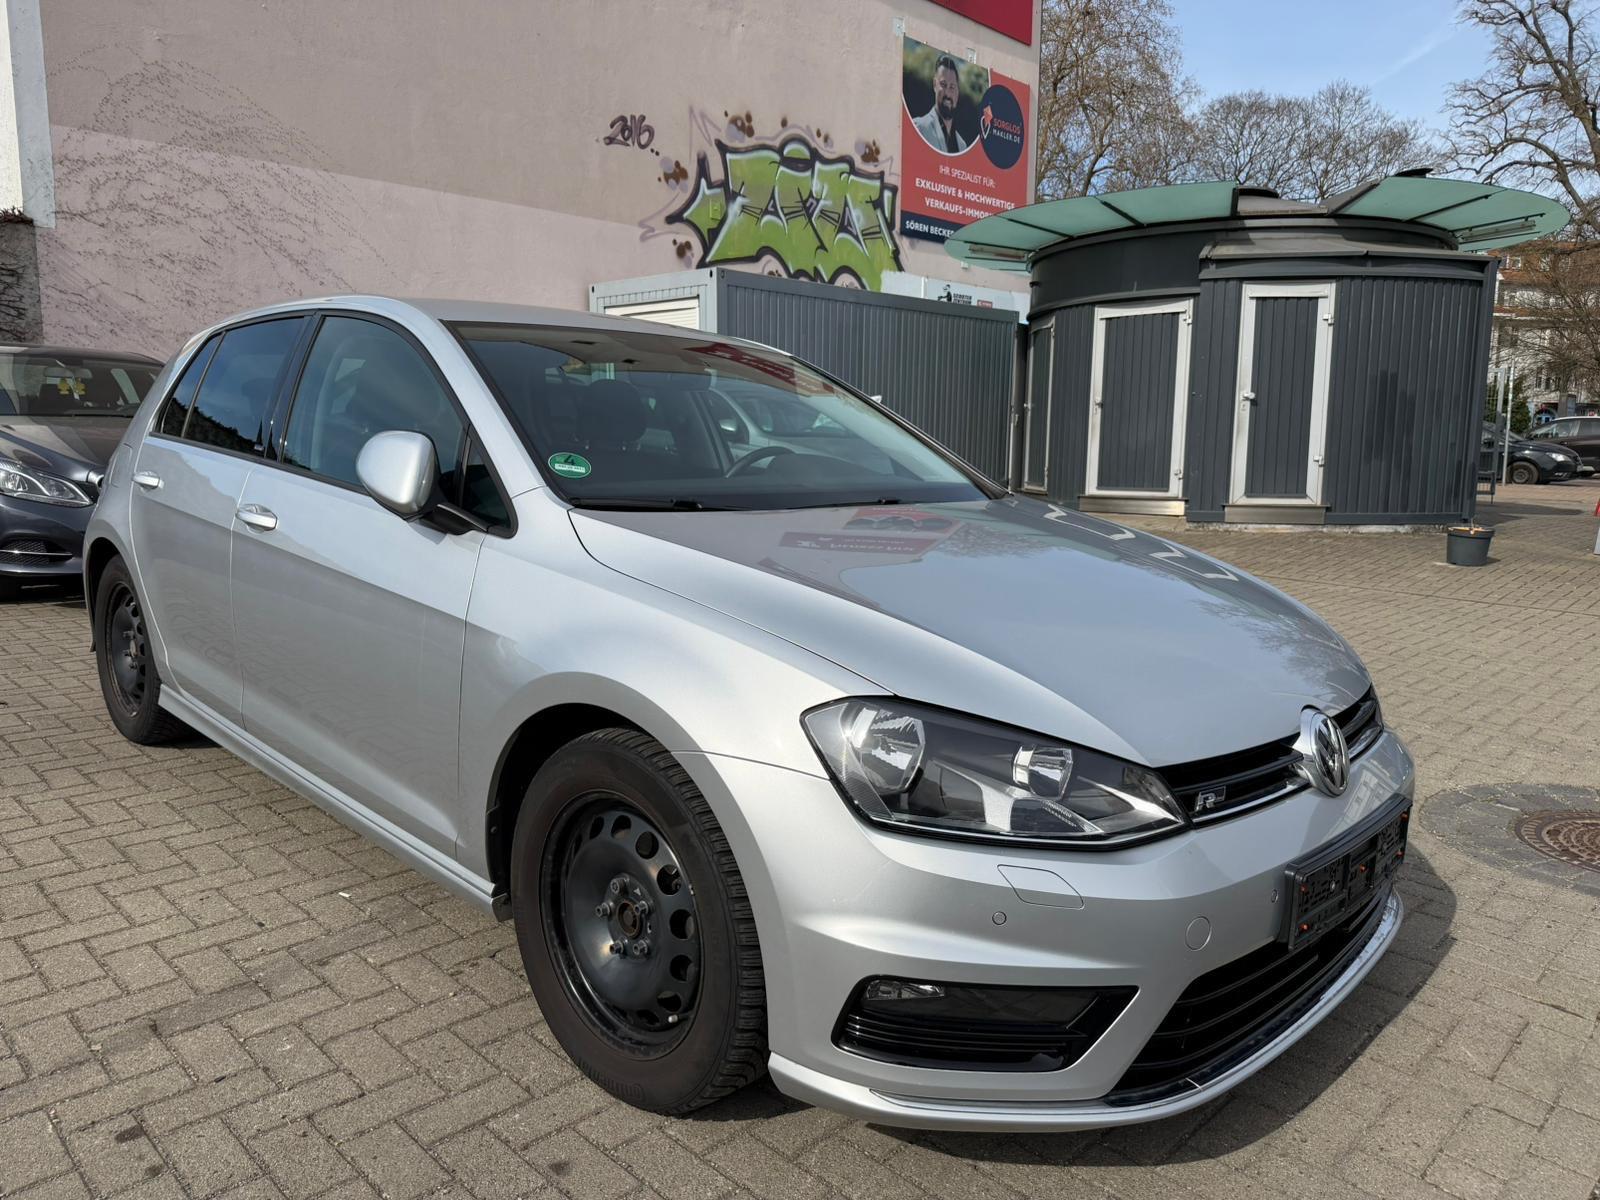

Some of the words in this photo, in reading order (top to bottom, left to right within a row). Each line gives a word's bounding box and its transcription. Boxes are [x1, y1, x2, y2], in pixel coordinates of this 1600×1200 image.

[603, 114, 655, 149] 2016
[993, 118, 1021, 135] SORGLOS
[992, 128, 1021, 144] MAKLER.DE
[939, 165, 951, 176] IHR
[951, 168, 982, 184] SPEZIALIST
[982, 176, 996, 188] FÜR:
[915, 178, 956, 196] EXKLUSIVE
[957, 189, 963, 198] &
[905, 220, 929, 233] SÖREN
